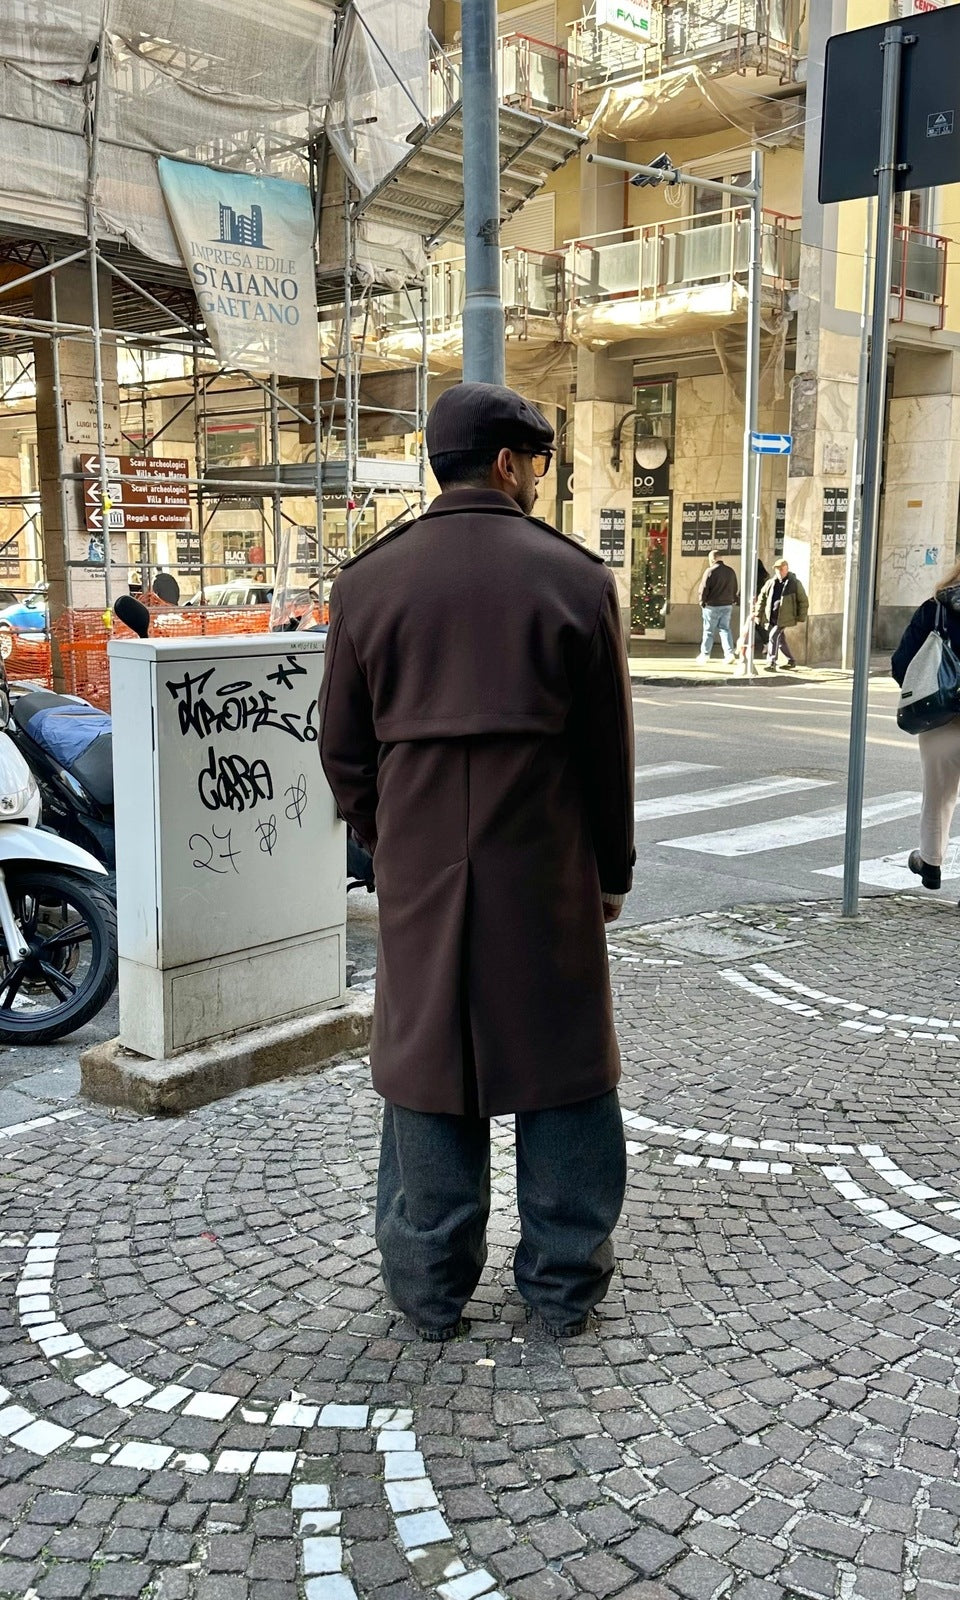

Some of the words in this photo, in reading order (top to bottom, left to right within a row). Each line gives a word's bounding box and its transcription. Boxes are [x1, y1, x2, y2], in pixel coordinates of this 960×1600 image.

[191, 241, 252, 269] IMPRESA
[256, 254, 297, 275] EDILE
[193, 262, 298, 301] STAIANO
[197, 290, 300, 326] GAETANO
[130, 458, 147, 467] Scavi
[149, 459, 186, 470] archeologici
[136, 469, 152, 479] Villa
[131, 484, 148, 492] Scavi
[150, 485, 187, 495] archeologici
[147, 495, 162, 504] Villa
[164, 496, 187, 504] Arianna
[126, 514, 149, 522] Reggia
[159, 514, 190, 522] Quisisana
[225, 551, 246, 560] BLACK
